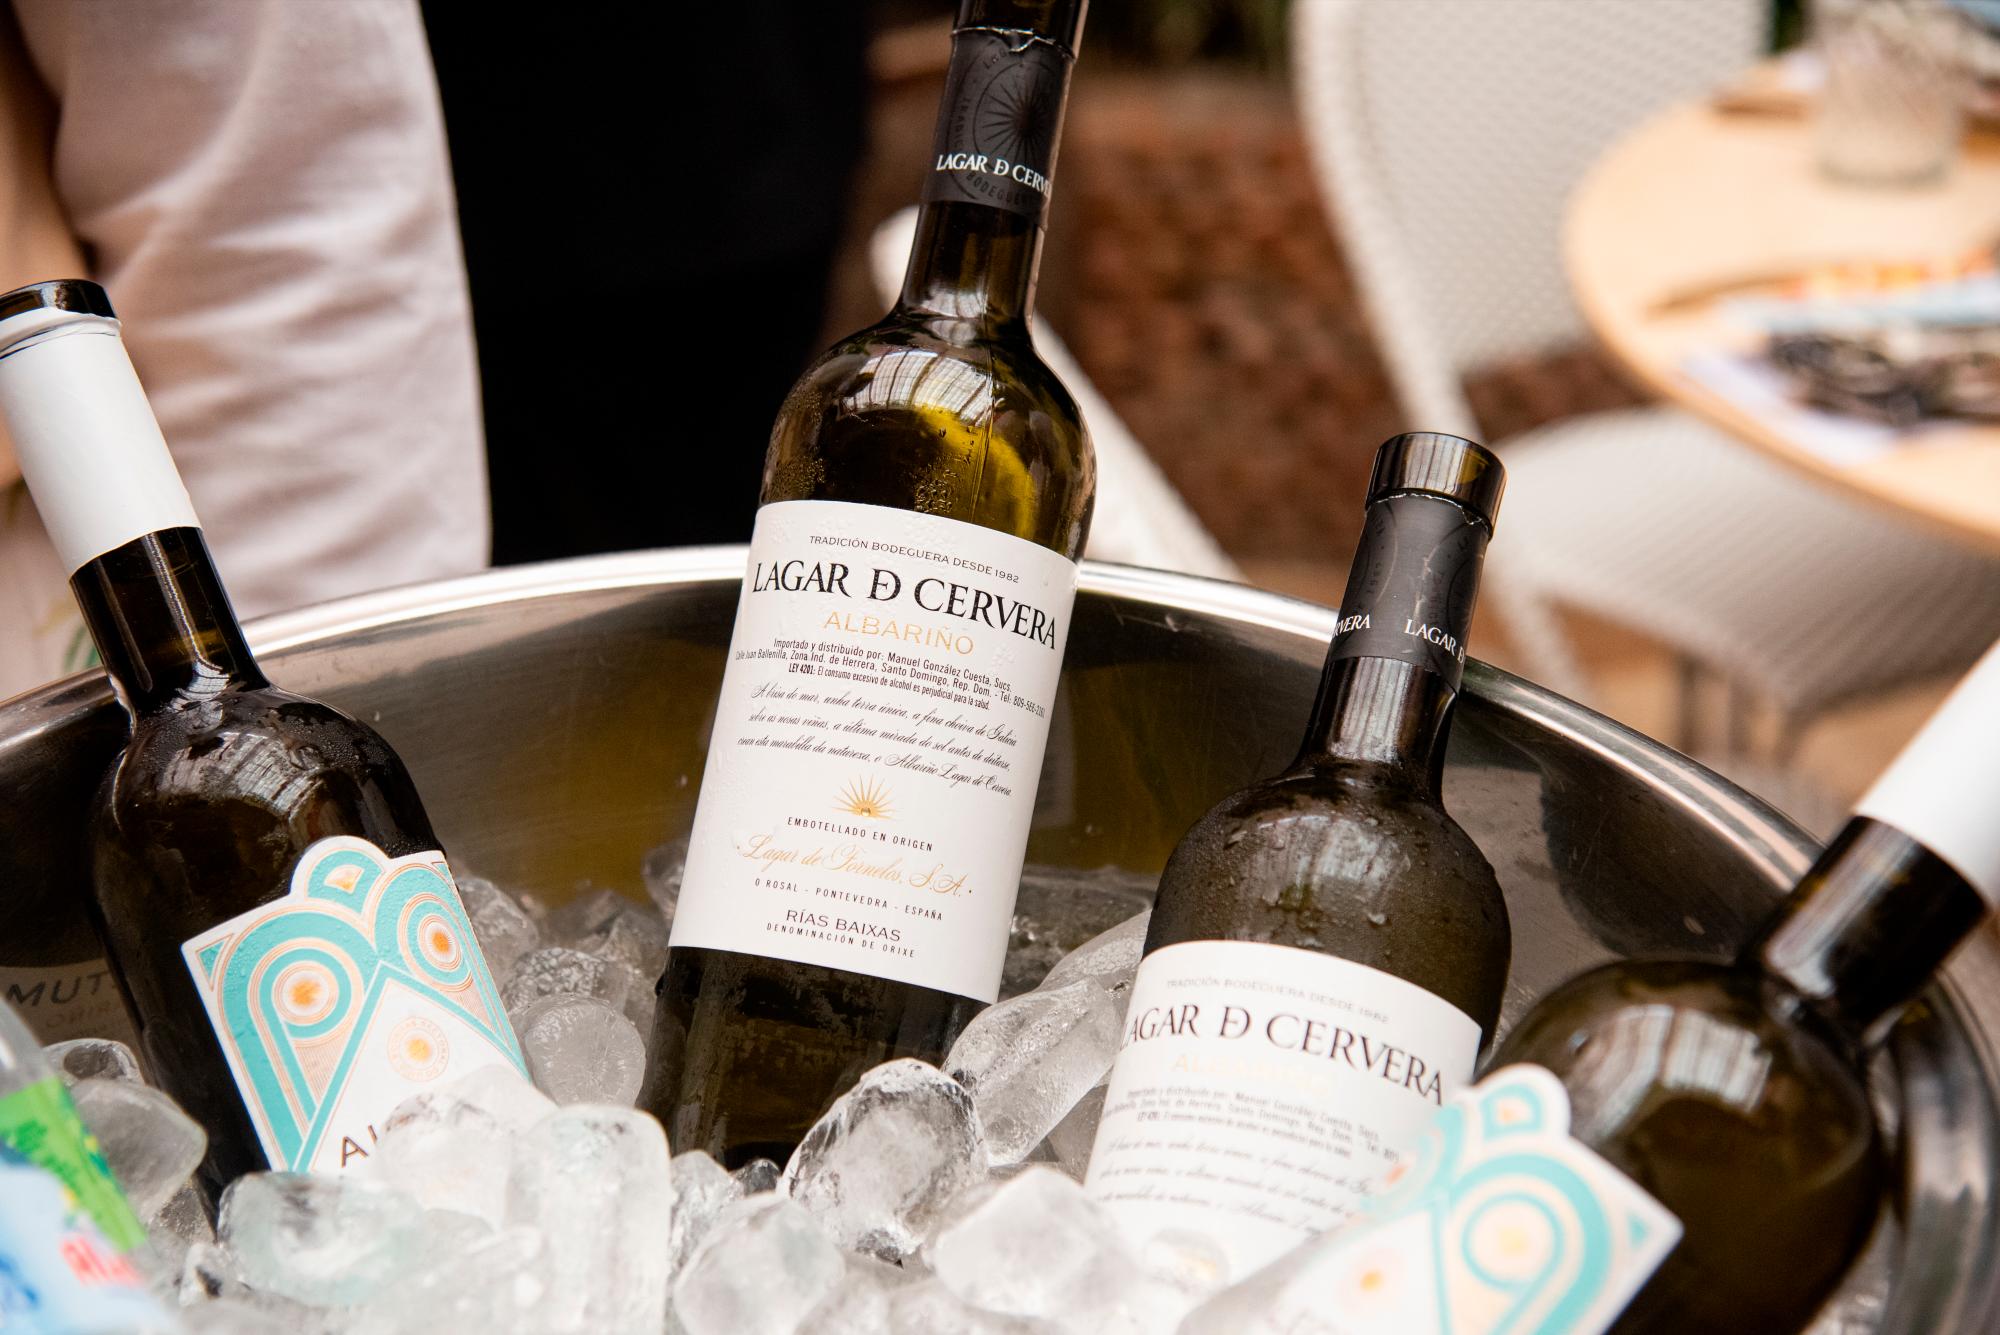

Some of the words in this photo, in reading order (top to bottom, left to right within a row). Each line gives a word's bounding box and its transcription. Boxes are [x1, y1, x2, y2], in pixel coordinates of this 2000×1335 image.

[936, 153, 987, 174] LAGAR
[809, 535, 869, 549] TRADICIÓN
[871, 540, 949, 564] BODEGUERA
[952, 557, 993, 575] DESDE
[995, 569, 1020, 583] 1982
[752, 559, 852, 598] LAGAR
[913, 577, 1056, 650] CERVERA
[823, 611, 974, 655] ALBARIÑO
[1404, 618, 1457, 656] LAGAR
[773, 638, 809, 650] Importado
[811, 643, 816, 651] y
[818, 642, 864, 657] distribuido
[866, 651, 884, 660] por:
[887, 652, 921, 667] Manuel
[923, 659, 961, 677] González
[790, 650, 808, 661] Zona
[810, 652, 826, 663] Ind.
[829, 654, 840, 664] de
[842, 659, 878, 672] Herrera,
[881, 663, 907, 676] Santo
[952, 679, 970, 692] Rep.
[973, 684, 992, 698] Dom.
[788, 662, 799, 673] LEY
[817, 666, 824, 675] El
[824, 669, 851, 680] consumo
[852, 673, 879, 685] excesivo
[880, 676, 888, 686] de
[889, 678, 912, 691] alcohol
[913, 684, 921, 692] es
[922, 685, 954, 700] perjudicial
[953, 694, 967, 704] para
[967, 696, 974, 705] la
[851, 697, 878, 712] terra
[912, 712, 921, 720] a
[915, 708, 943, 727] fina
[833, 722, 840, 731] a
[931, 738, 955, 751] sol
[787, 816, 867, 838] EMBOTELLADO
[872, 831, 887, 842] EN
[892, 835, 933, 852] ORIGEN
[754, 878, 760, 887] O
[765, 879, 799, 893] ROSAL
[815, 887, 888, 909] PONTEVEDRA
[904, 904, 943, 921] ESPAÑA
[766, 922, 855, 945] DENOMINACIÓN
[861, 940, 875, 950] DE
[882, 944, 915, 958] ORIXE
[786, 908, 829, 928] RÍAS
[835, 918, 901, 942] BAIXAS
[1266, 1013, 1444, 1107] CERVERA
